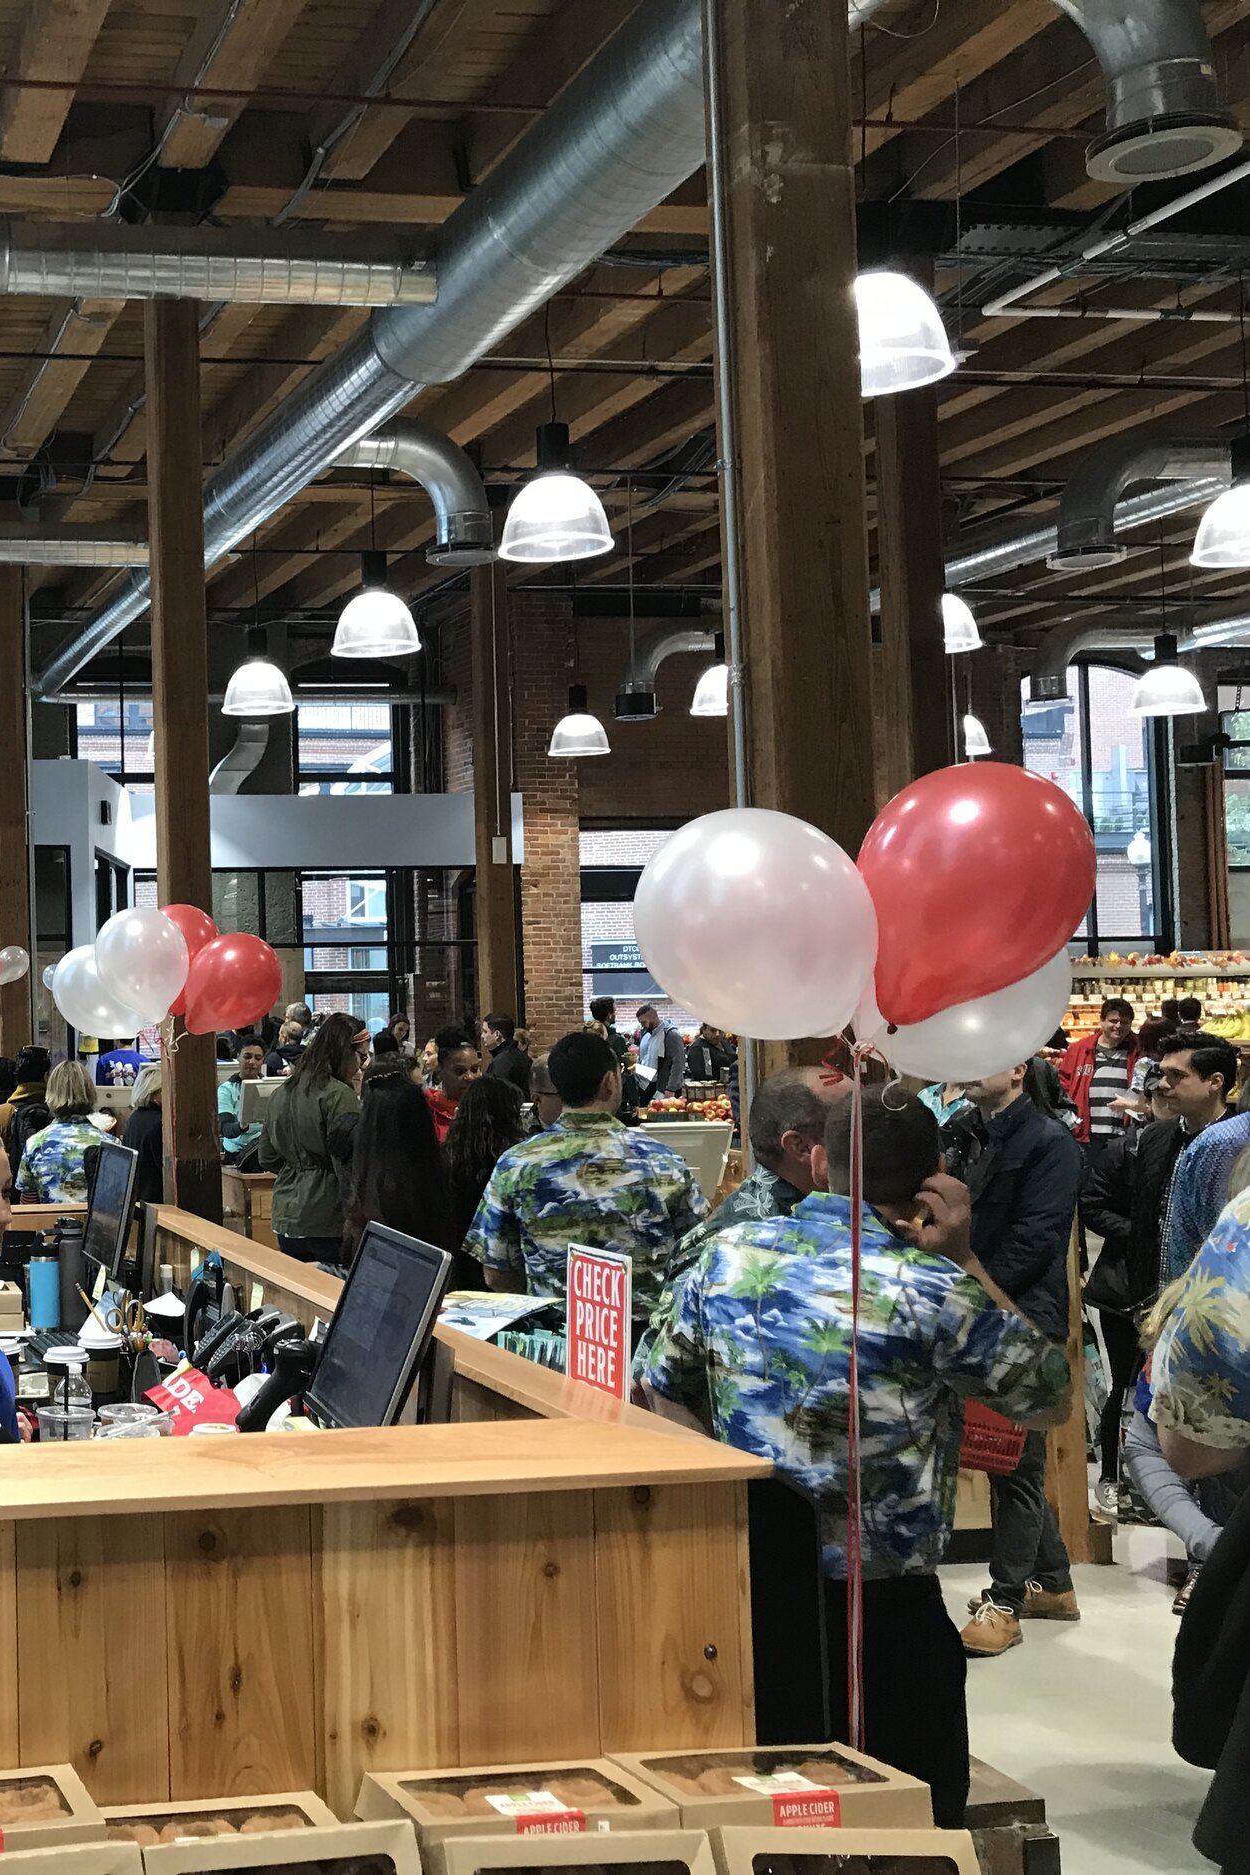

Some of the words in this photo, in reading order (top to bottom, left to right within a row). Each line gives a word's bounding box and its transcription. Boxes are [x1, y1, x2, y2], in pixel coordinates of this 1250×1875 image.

[609, 953, 642, 961] OUTSYST
[573, 1259, 622, 1308] CHECK
[575, 1299, 619, 1348] PRICE
[577, 1339, 617, 1388] HERE
[779, 1803, 809, 1818] APPLE
[809, 1800, 836, 1815] CIDER
[523, 1823, 552, 1835] APPLE
[552, 1820, 581, 1834] CIDER
